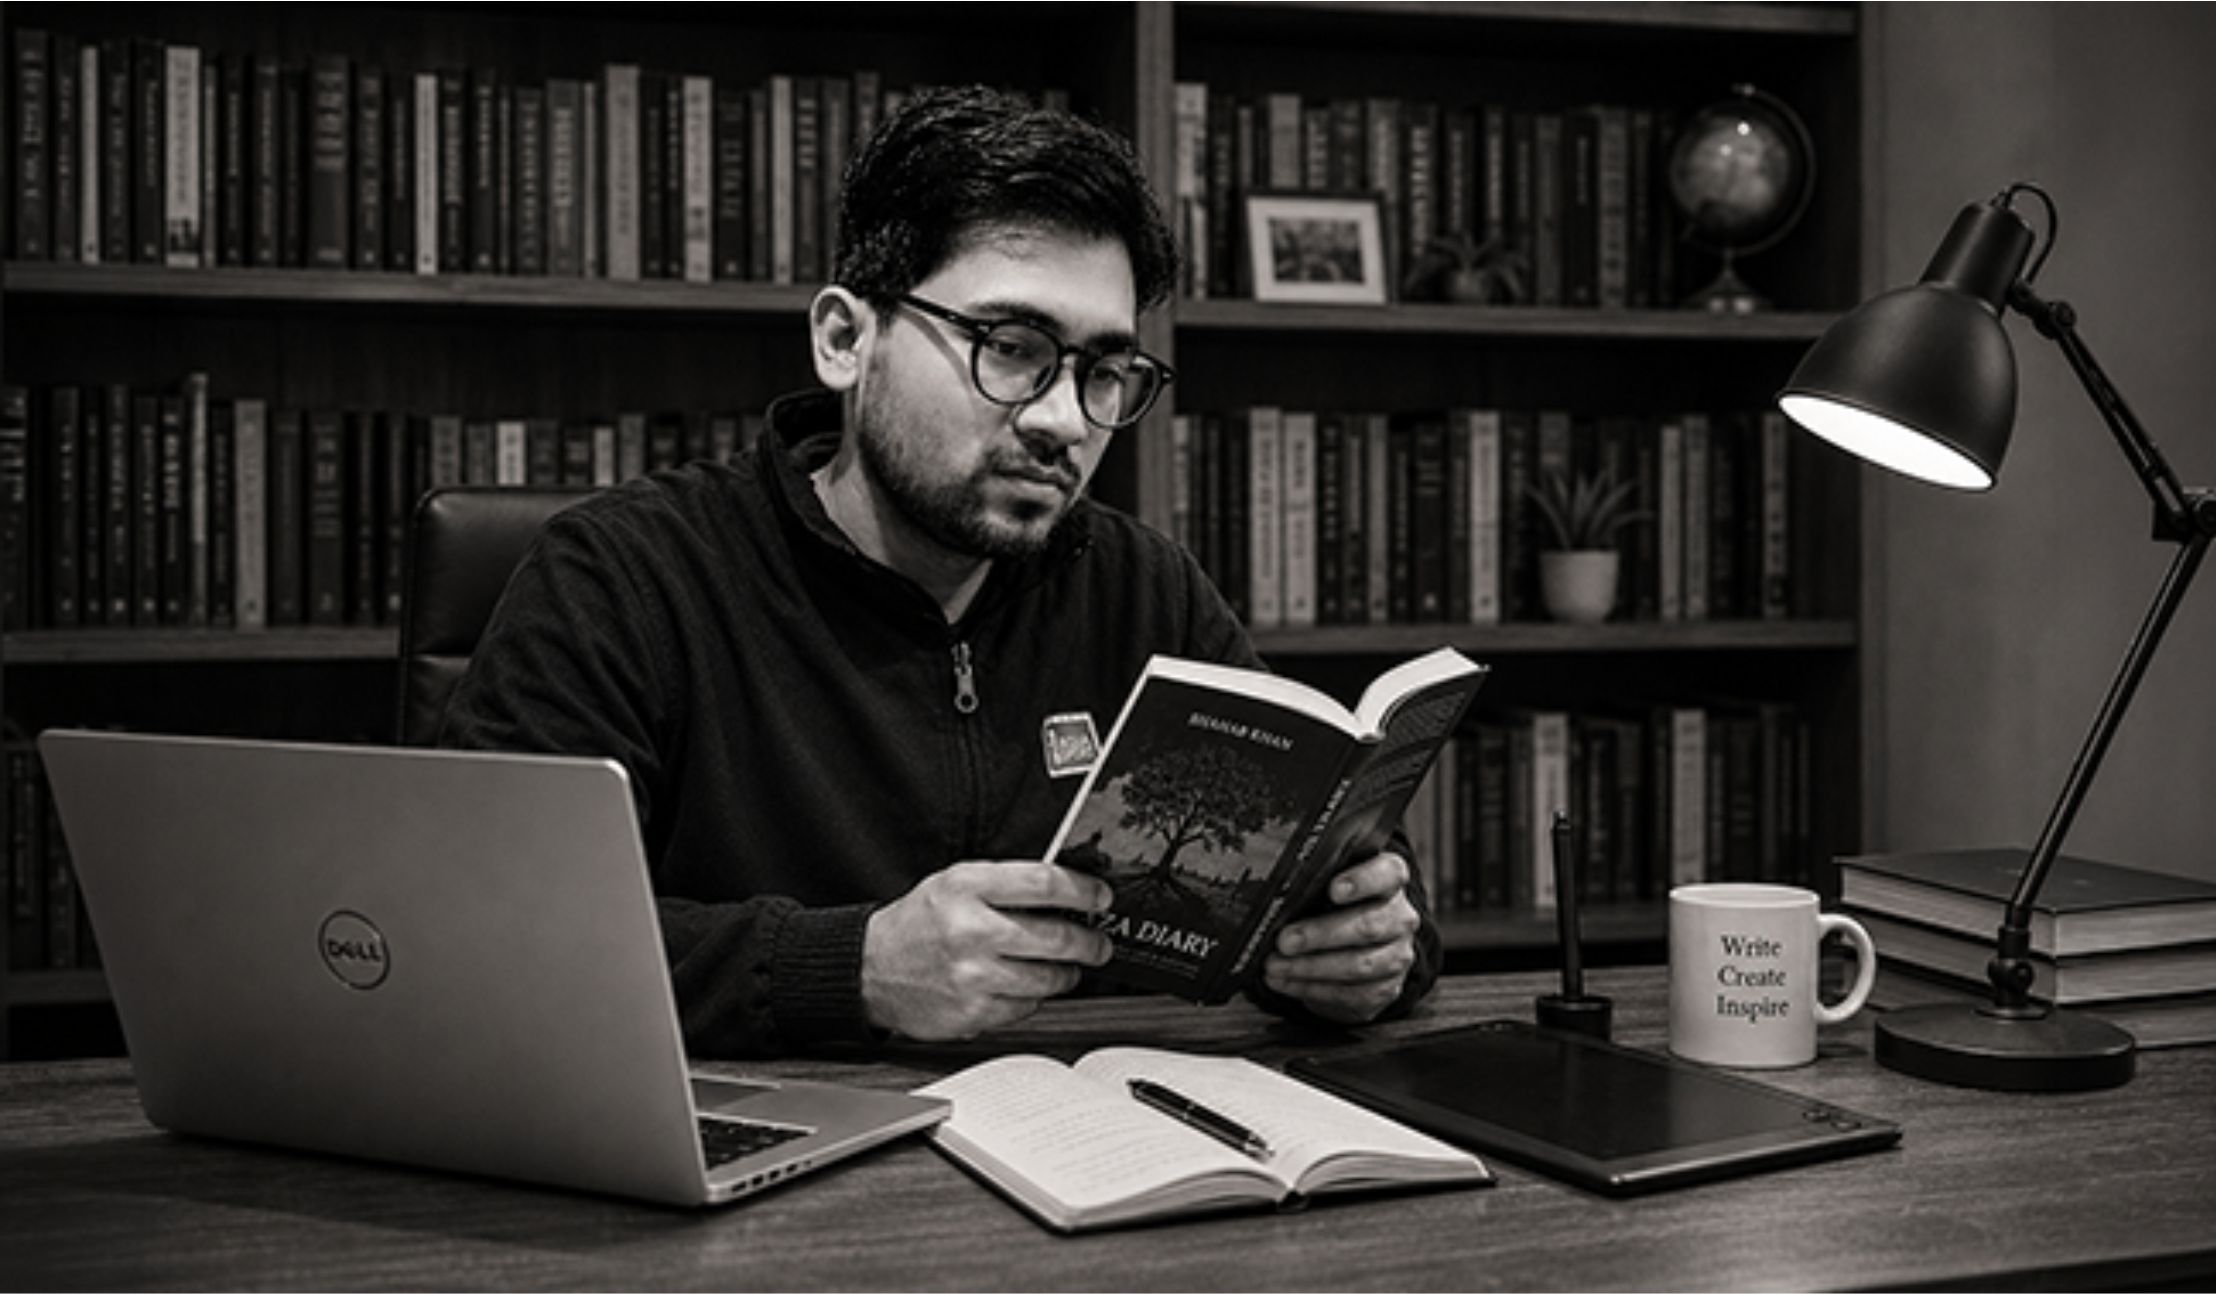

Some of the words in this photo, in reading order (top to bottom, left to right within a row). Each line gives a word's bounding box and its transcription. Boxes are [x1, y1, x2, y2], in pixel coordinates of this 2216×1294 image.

[327, 938, 382, 962] DELL
[1135, 919, 1220, 958] DIARY
[1720, 934, 1783, 957] Write
[1717, 964, 1787, 988] Create
[1716, 994, 1790, 1024] Inspire
